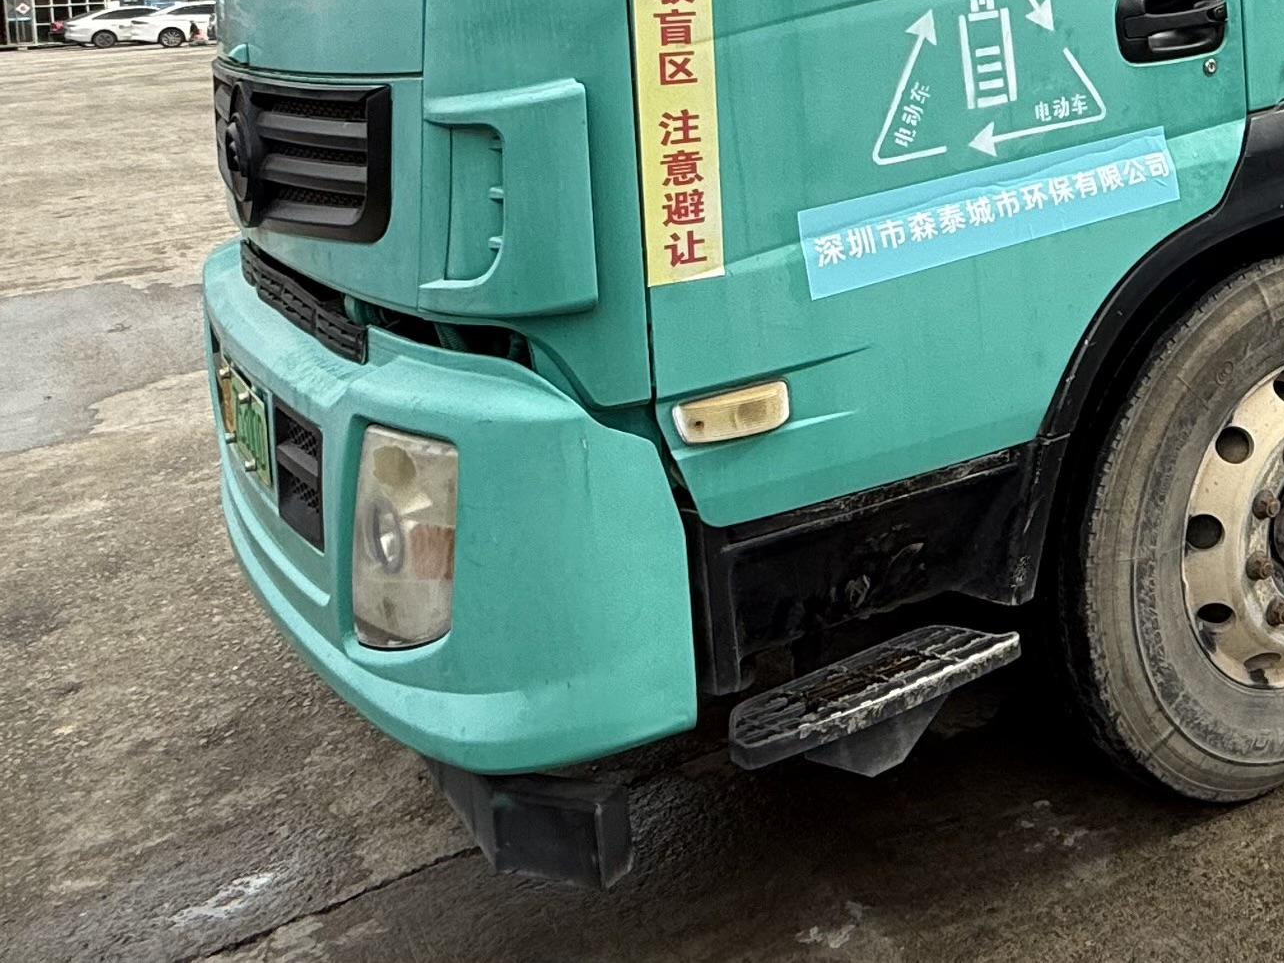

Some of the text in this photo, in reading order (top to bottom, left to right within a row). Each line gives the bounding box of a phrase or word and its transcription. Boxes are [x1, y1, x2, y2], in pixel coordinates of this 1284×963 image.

[894, 82, 931, 147] 电动车
[1035, 94, 1088, 122] 电动车
[813, 152, 1170, 268] 深圳市森泰城市环保有限公司
